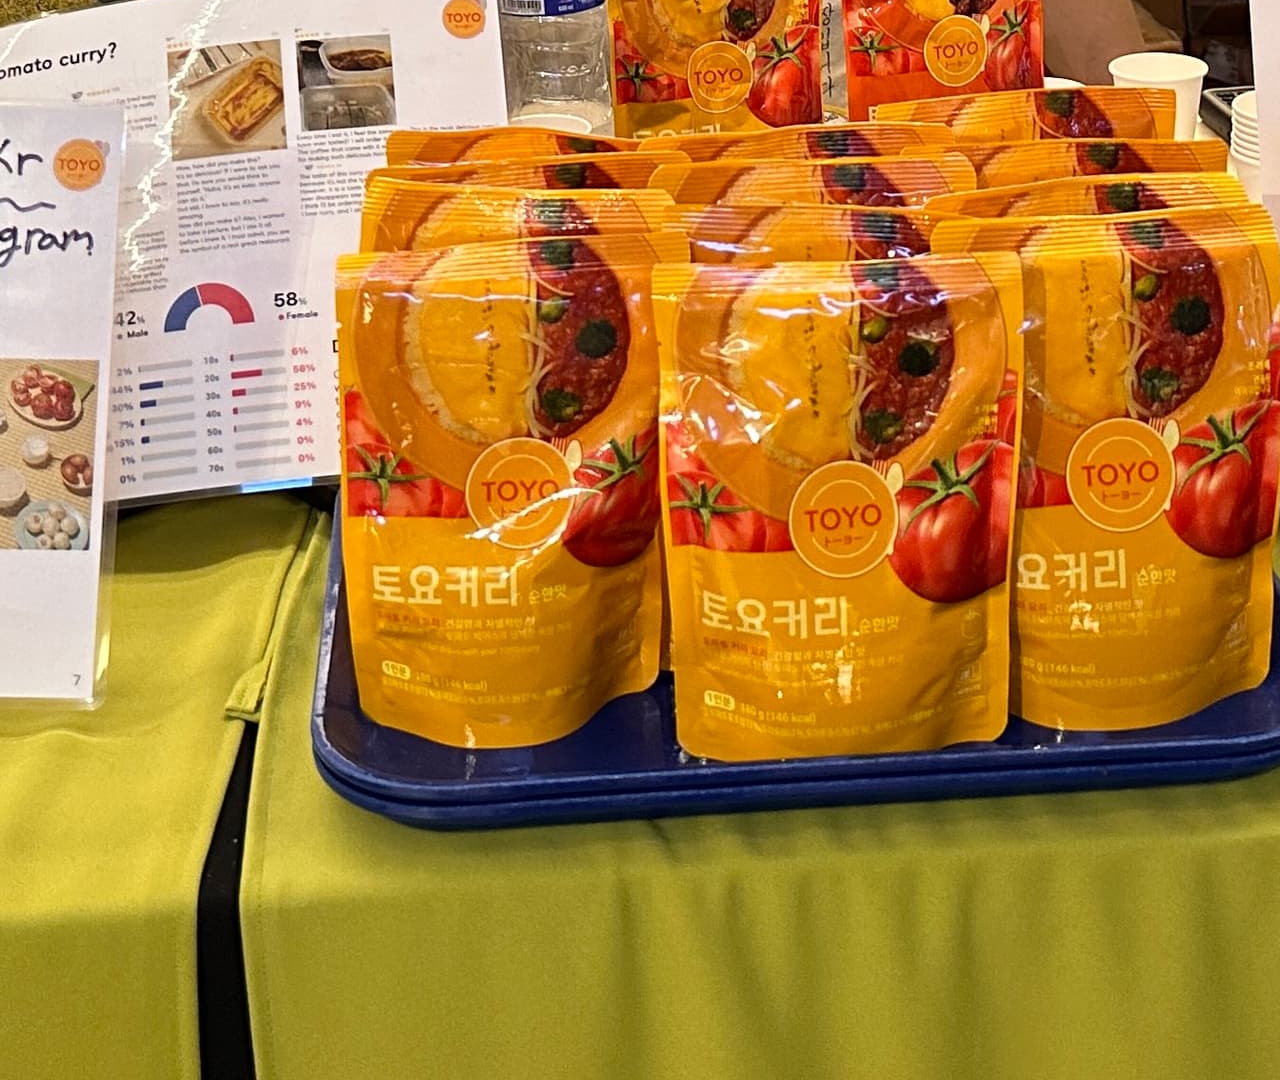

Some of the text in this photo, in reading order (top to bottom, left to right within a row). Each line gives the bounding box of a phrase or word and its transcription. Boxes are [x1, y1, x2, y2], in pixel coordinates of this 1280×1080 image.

[446, 11, 481, 23] TOYO
[59, 42, 117, 67] curry?
[933, 40, 978, 62] TOYO
[694, 68, 744, 85] TOYO
[57, 158, 101, 173] TOYO
[274, 292, 307, 308] 58%
[286, 310, 319, 320] Female
[127, 329, 148, 339] Male
[1081, 460, 1159, 488] TOYO
[481, 480, 560, 502] TOYO
[804, 503, 882, 533] TOYO
[1017, 548, 1127, 592] 요커리
[372, 565, 519, 607] 토요커리
[702, 590, 849, 639] 토요커리
[73, 674, 81, 686] 7
